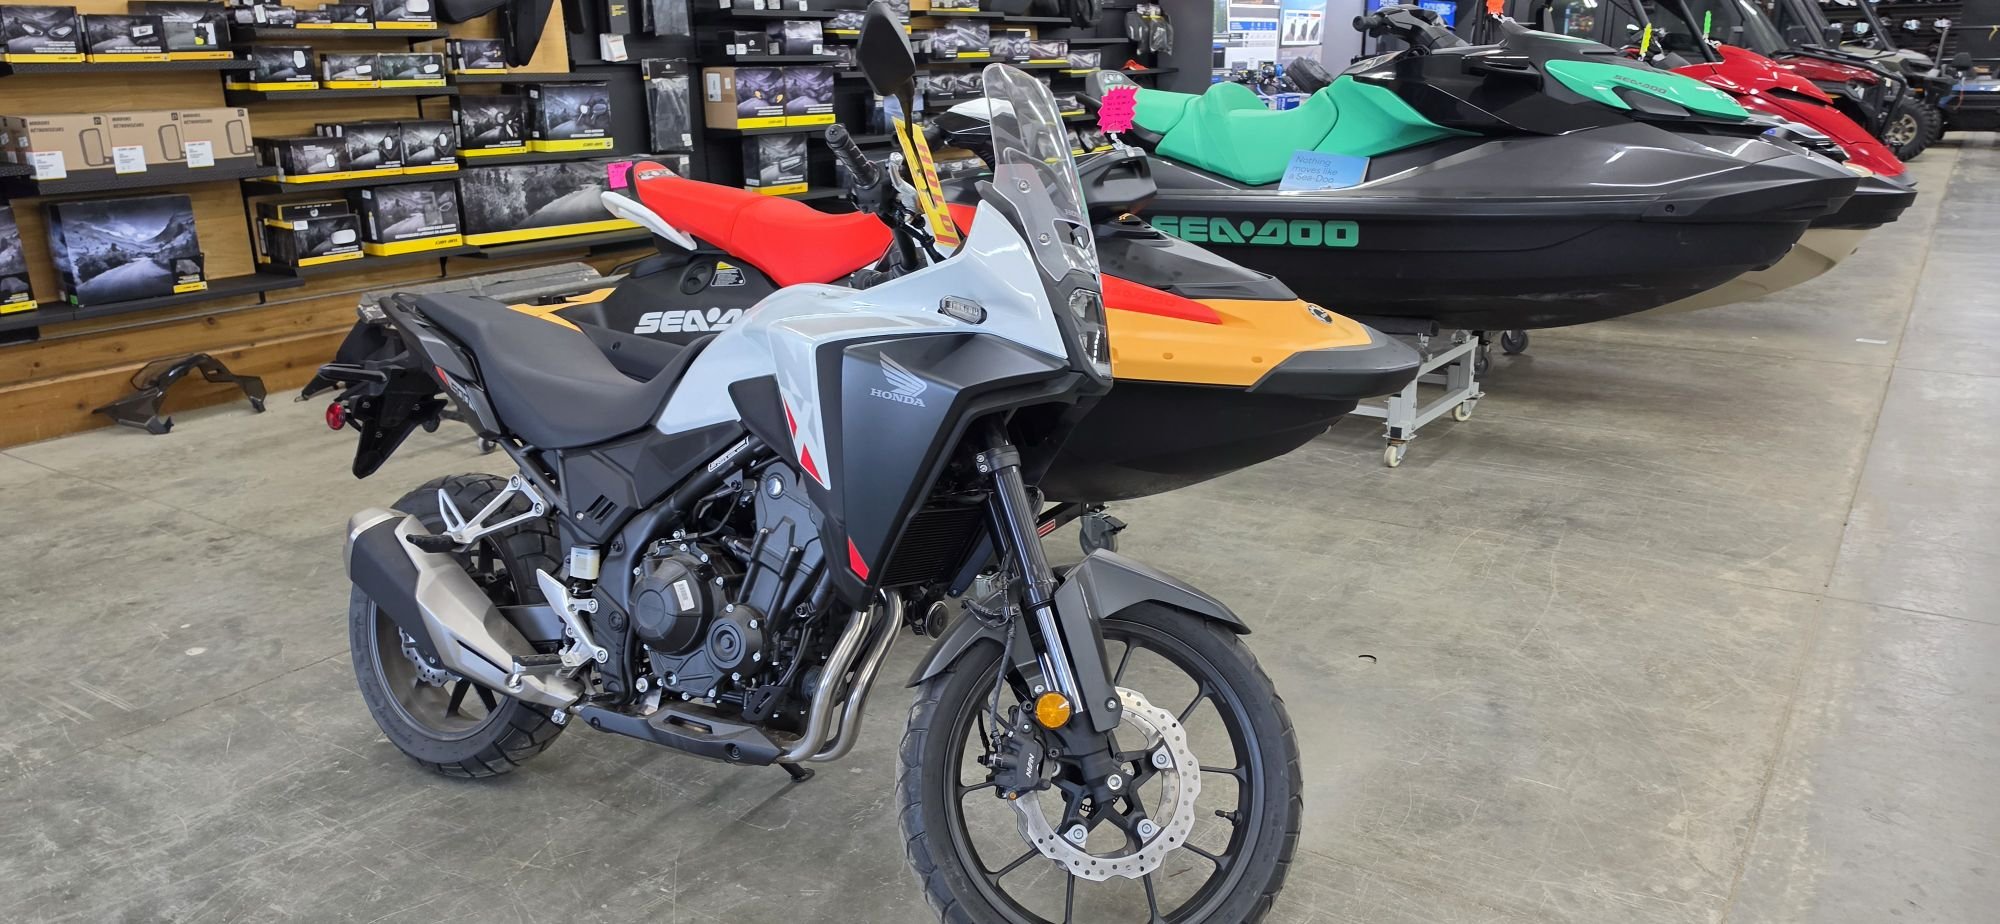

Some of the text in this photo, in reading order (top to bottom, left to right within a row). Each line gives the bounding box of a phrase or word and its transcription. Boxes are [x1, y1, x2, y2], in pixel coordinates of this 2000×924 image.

[1295, 155, 1332, 167] Nothing
[1294, 166, 1338, 176] moves like
[1295, 172, 1334, 183] Sea-Doo
[870, 388, 926, 407] HONDA
